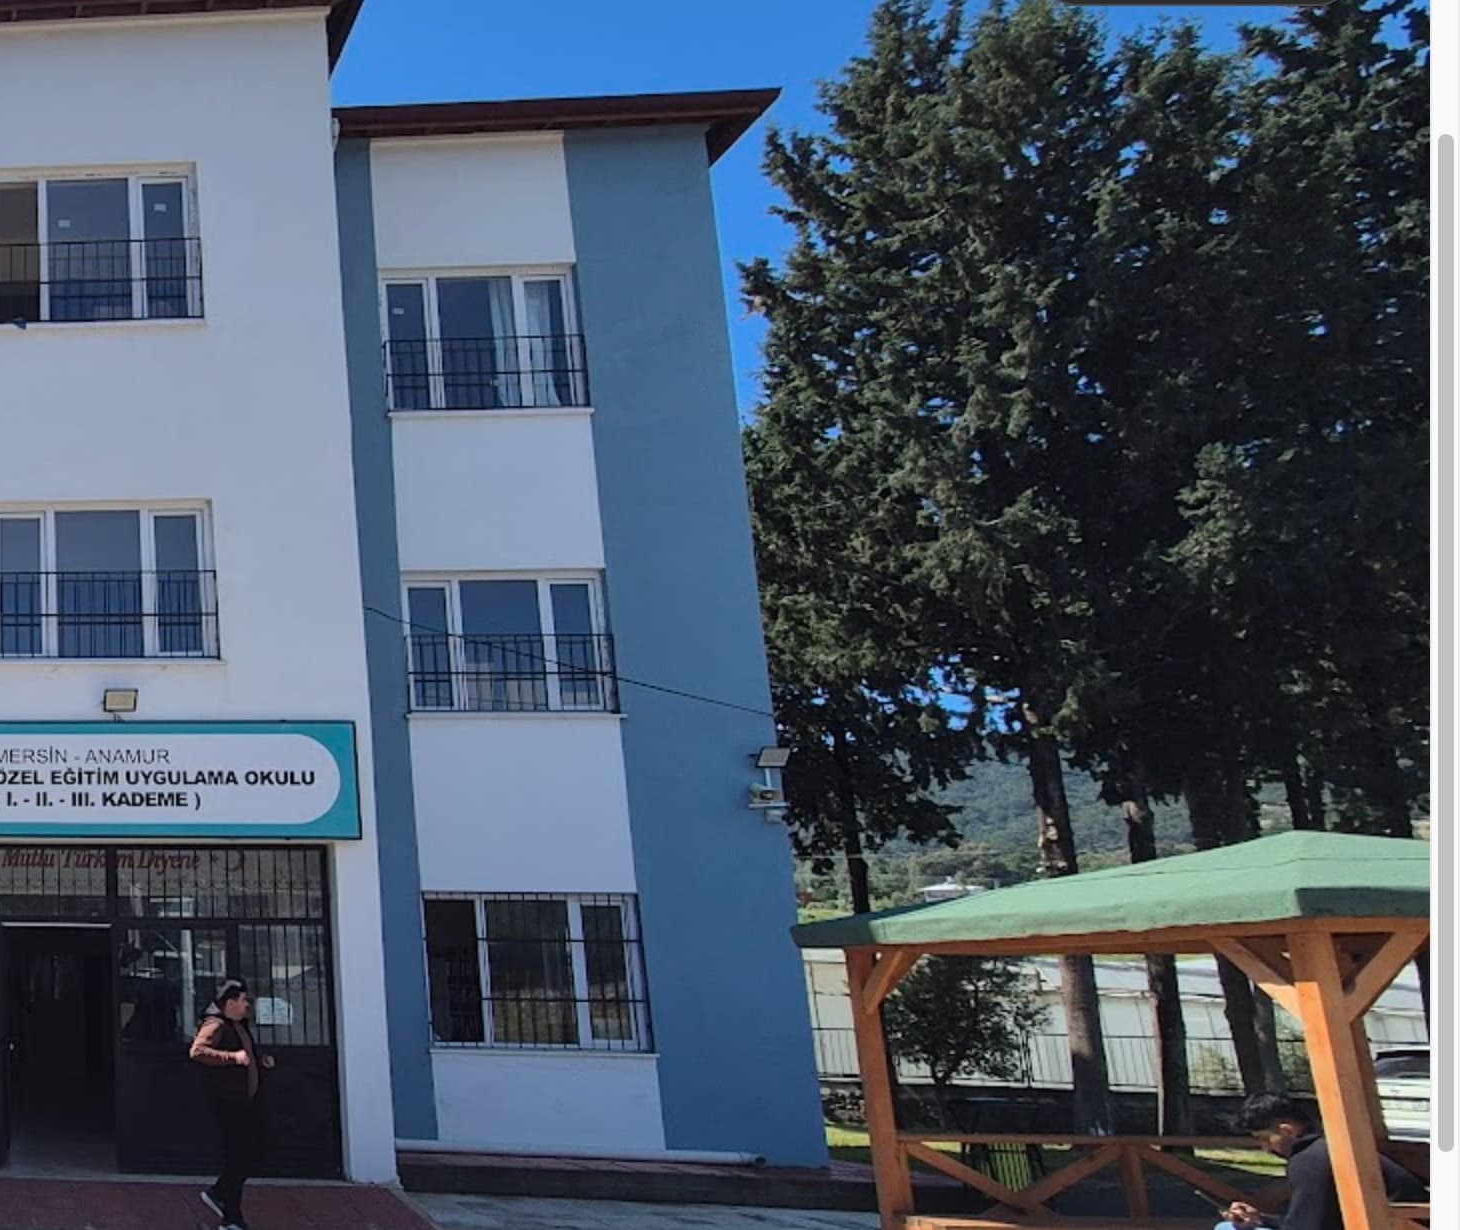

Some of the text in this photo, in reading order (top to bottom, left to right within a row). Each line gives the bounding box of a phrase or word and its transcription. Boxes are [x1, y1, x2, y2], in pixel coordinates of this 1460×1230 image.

[85, 749, 171, 764] ANAMUR
[50, 767, 119, 786] EĞİTİM
[125, 770, 239, 786] UYGULAMA
[244, 770, 315, 786] OKULU
[102, 792, 189, 807] KADEME
